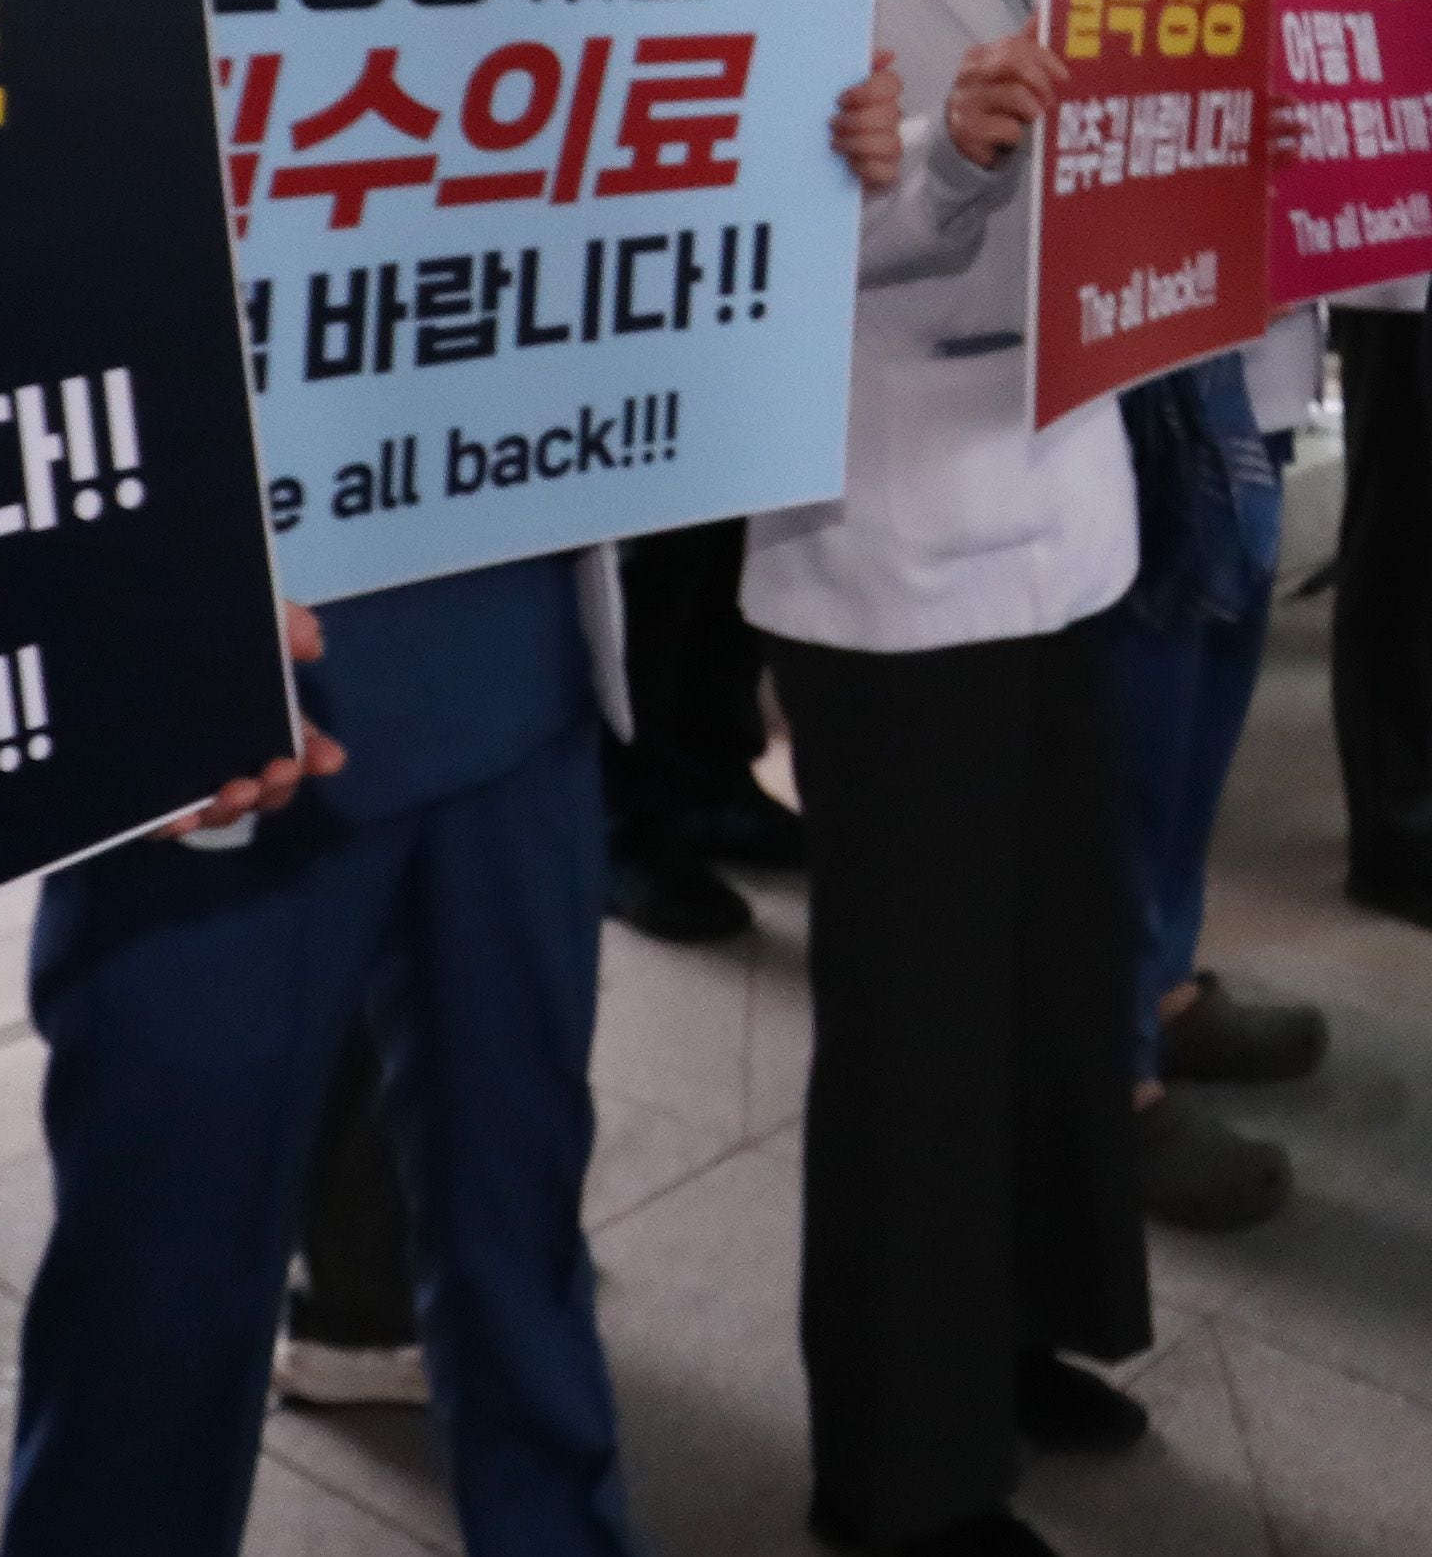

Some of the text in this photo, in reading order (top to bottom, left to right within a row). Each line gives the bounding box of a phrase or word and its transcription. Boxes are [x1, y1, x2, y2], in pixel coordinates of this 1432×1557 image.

[303, 223, 772, 383] 바랍니다!!
[330, 434, 422, 520] all
[444, 391, 680, 499] back!!!
